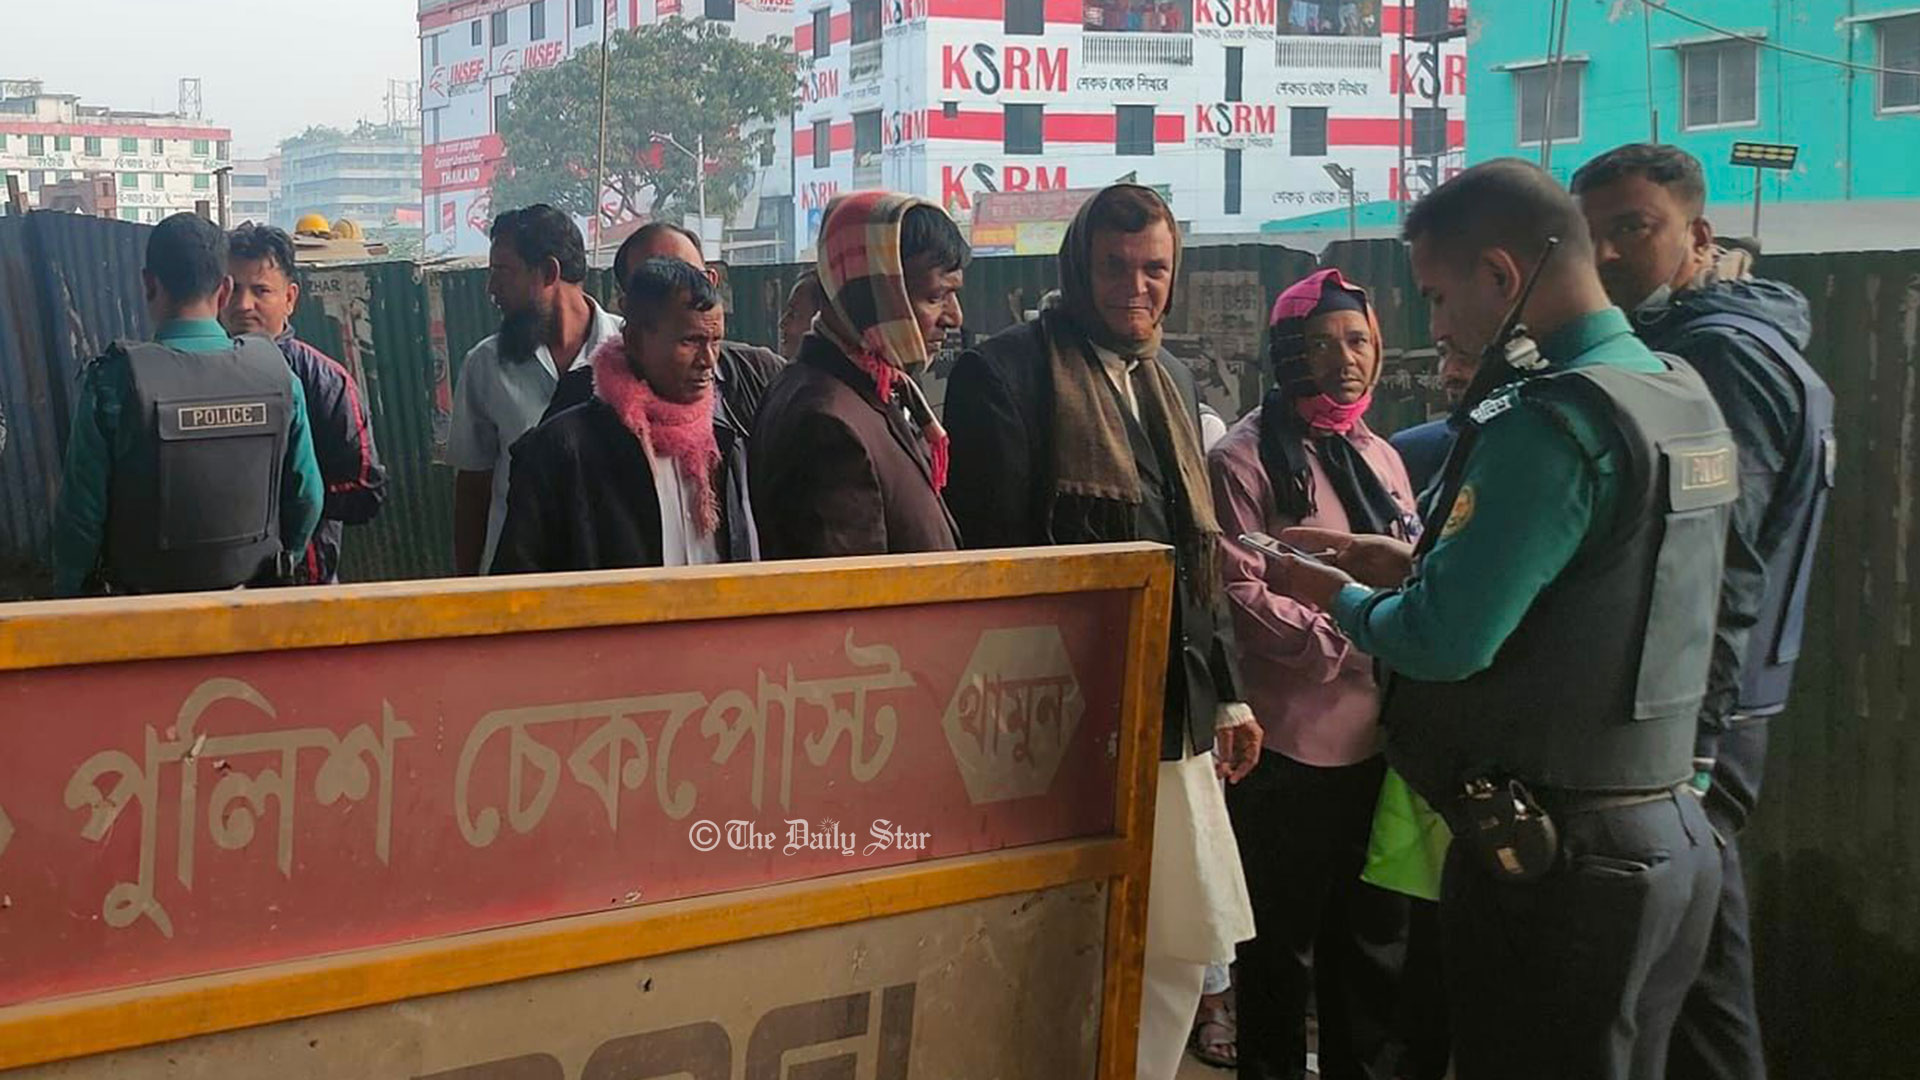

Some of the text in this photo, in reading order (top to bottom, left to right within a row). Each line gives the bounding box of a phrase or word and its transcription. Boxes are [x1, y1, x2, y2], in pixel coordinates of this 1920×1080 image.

[1195, 0, 1275, 27] KSRM
[942, 43, 1070, 95] KSRM
[1196, 103, 1276, 136] KSRM
[193, 407, 253, 426] POLICE
[64, 628, 917, 938] পুলিশ চেকপোস্ট
